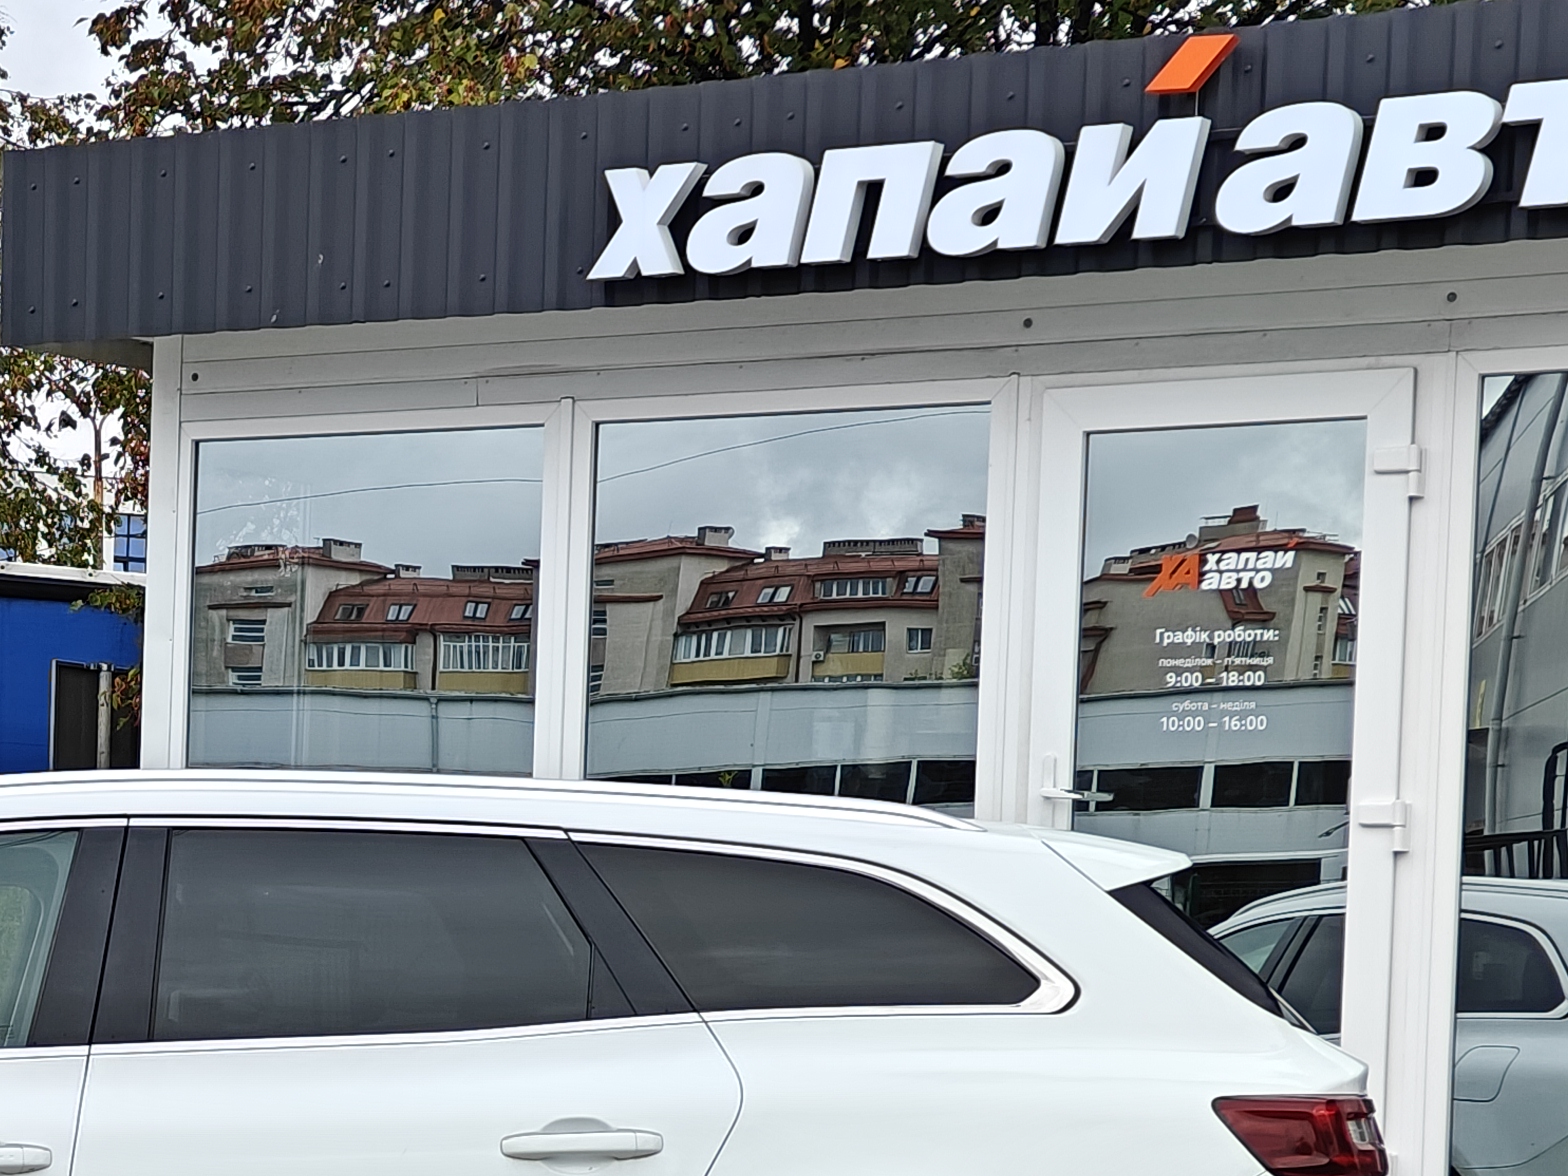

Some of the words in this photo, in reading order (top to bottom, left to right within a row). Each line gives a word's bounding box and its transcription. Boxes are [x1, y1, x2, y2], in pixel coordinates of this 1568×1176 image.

[586, 34, 1240, 281] хапай
[1200, 570, 1273, 590] авто
[1154, 626, 1211, 646] Графік
[1213, 625, 1280, 645] роботи:
[1158, 656, 1214, 667] понеділок
[1165, 672, 1202, 687] 9:00
[1219, 670, 1265, 686] 18:00
[1172, 700, 1209, 712] субота
[1220, 700, 1256, 711] неділя
[1160, 716, 1205, 731] 10:00
[1222, 715, 1267, 730] 16:00
